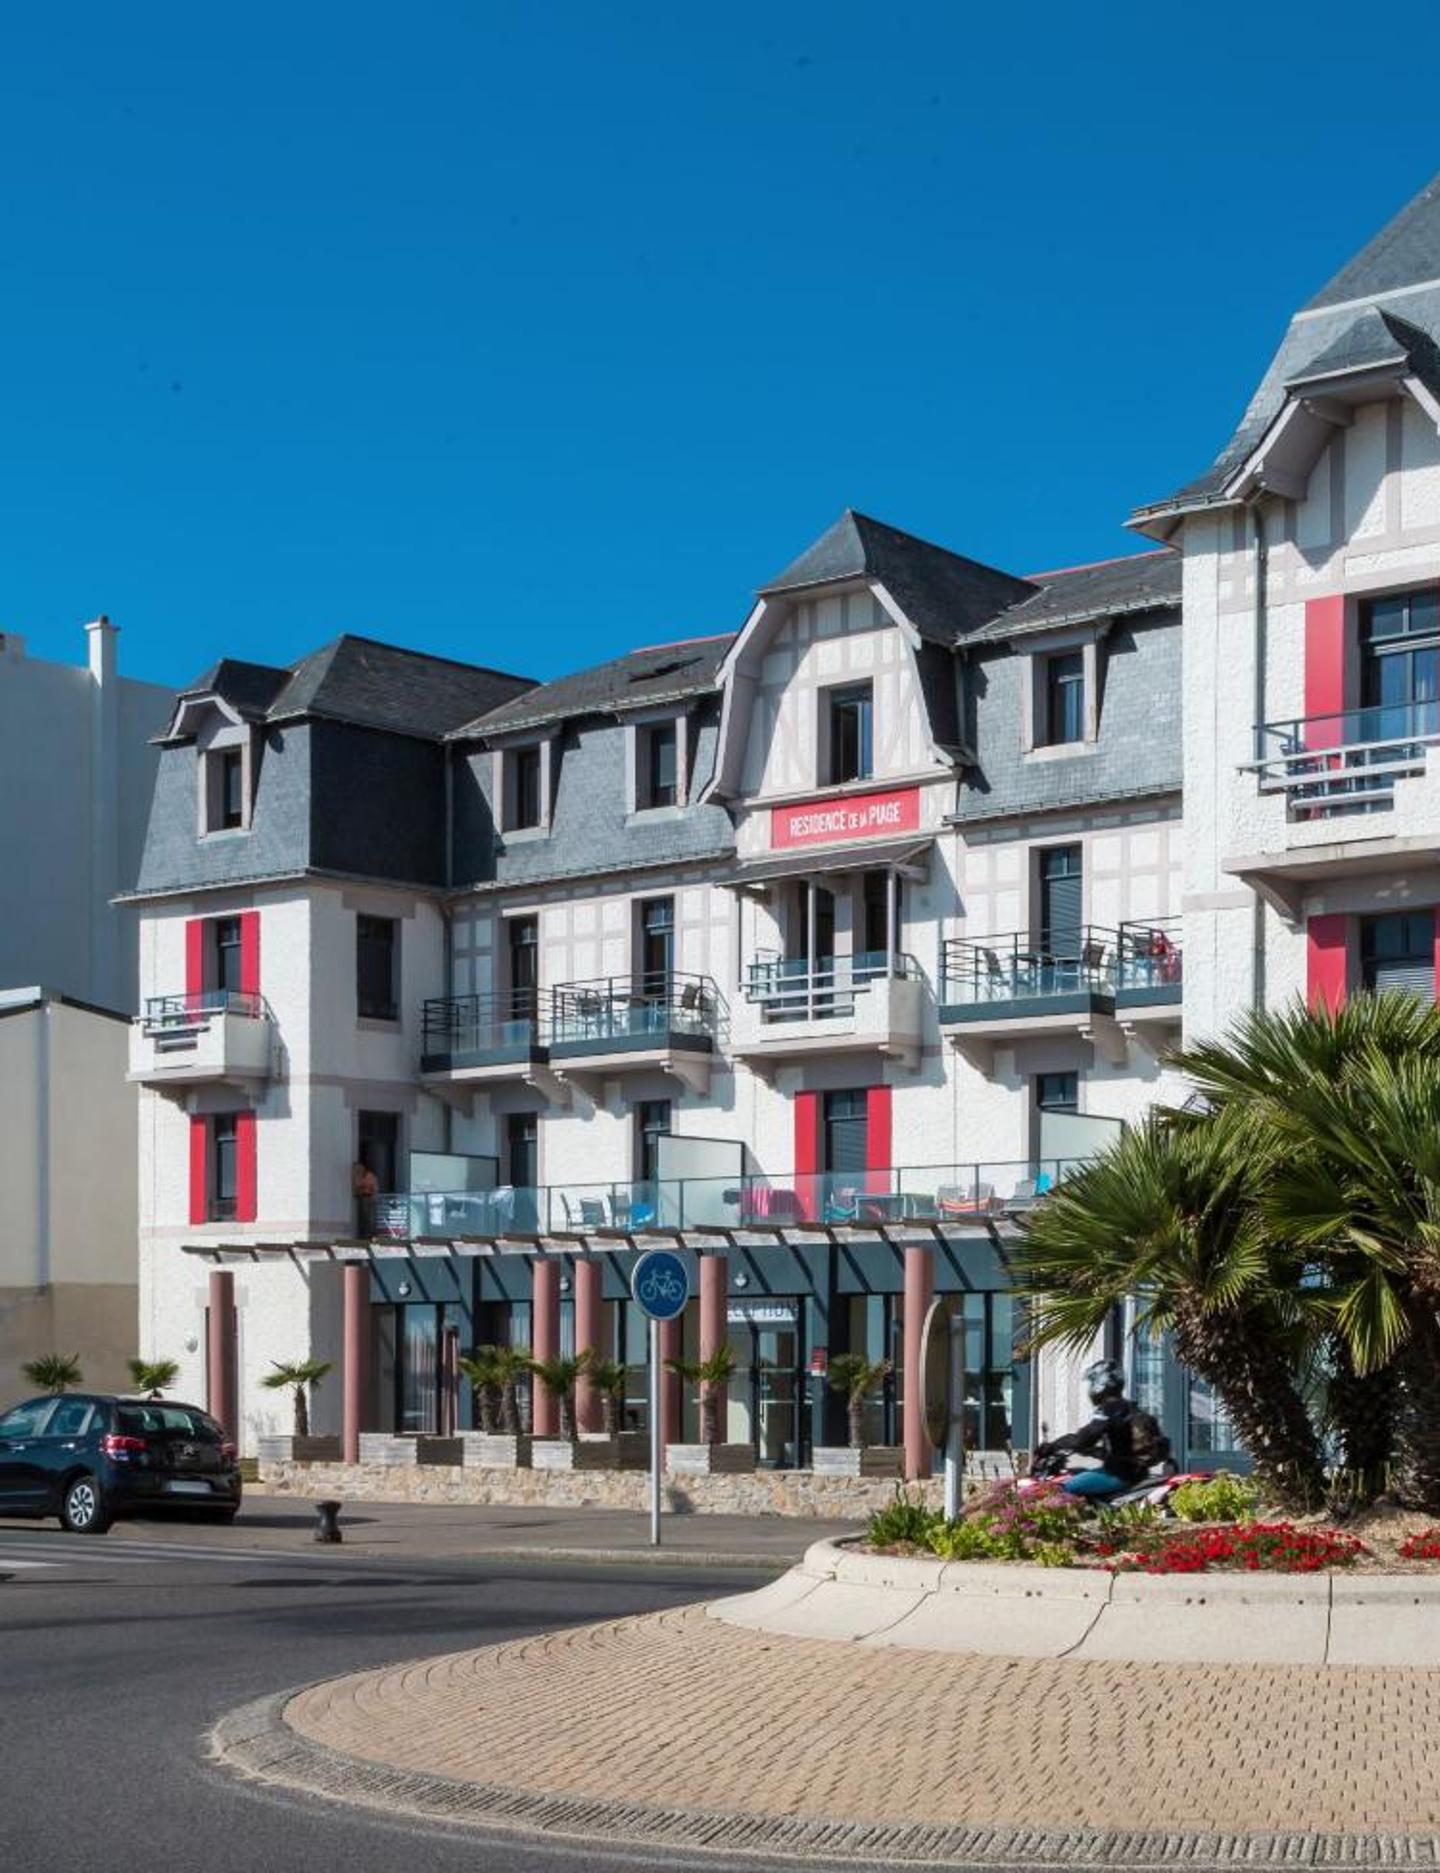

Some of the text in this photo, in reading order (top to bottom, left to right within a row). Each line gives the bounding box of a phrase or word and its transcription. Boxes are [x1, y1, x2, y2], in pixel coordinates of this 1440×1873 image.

[790, 810, 846, 837] RESIDENCE
[848, 812, 859, 829] DE
[868, 801, 901, 826] PLAGE
